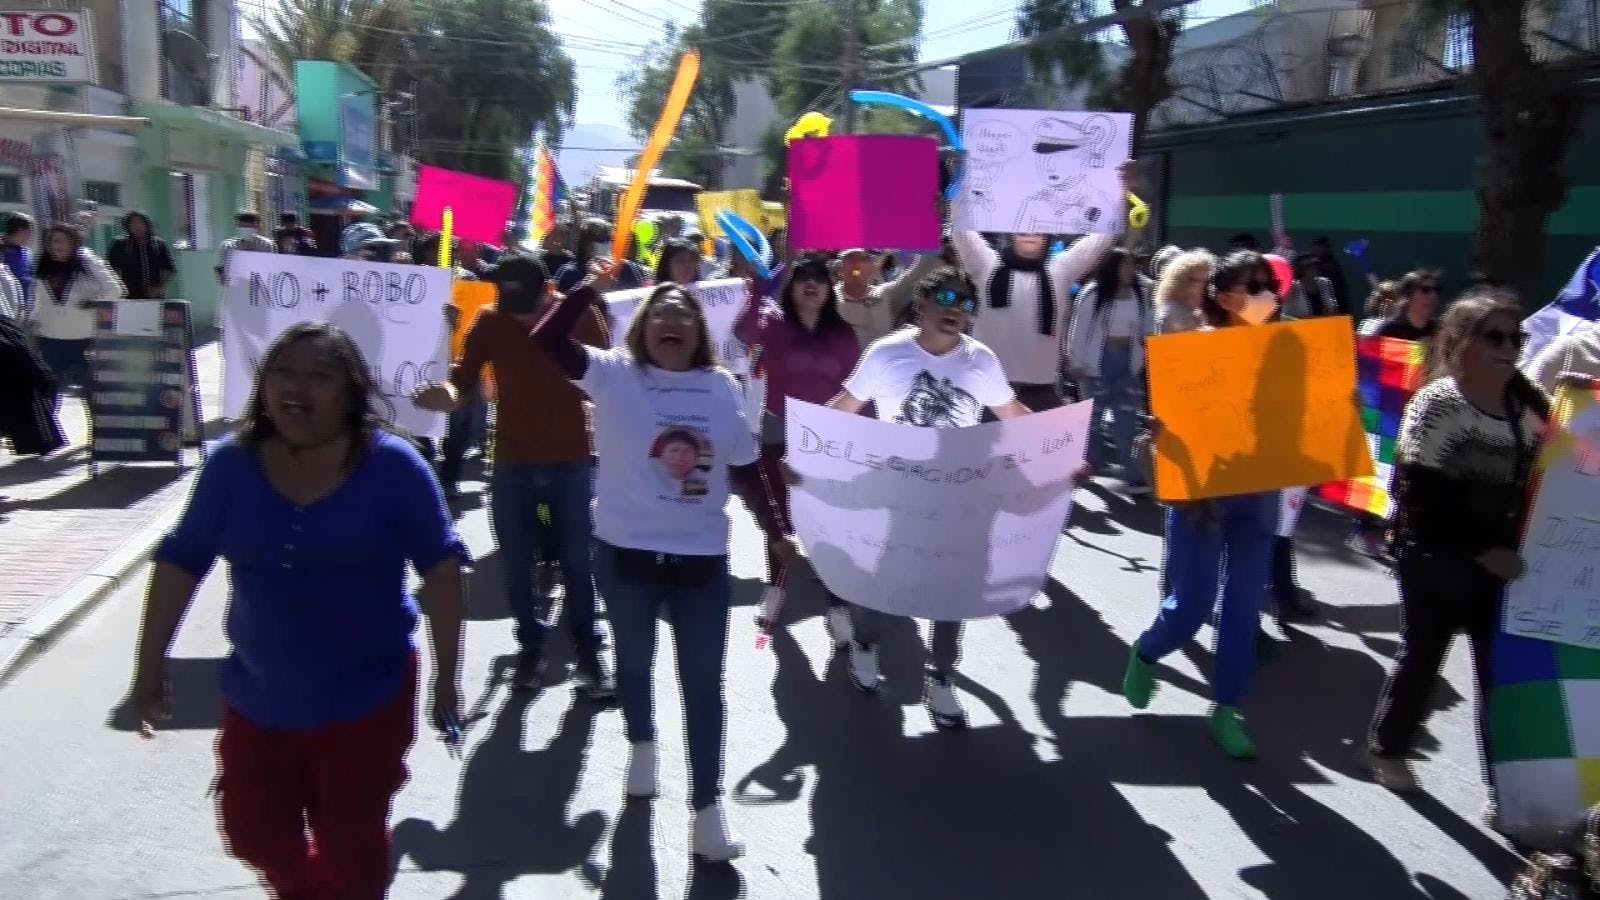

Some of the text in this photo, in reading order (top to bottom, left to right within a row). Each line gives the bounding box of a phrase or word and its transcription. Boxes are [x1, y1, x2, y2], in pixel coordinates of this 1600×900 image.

[0, 13, 78, 36] TO
[3, 41, 83, 56] DIGITAL
[250, 270, 427, 308] NO + ROBO
[1003, 452, 1032, 470] EL
